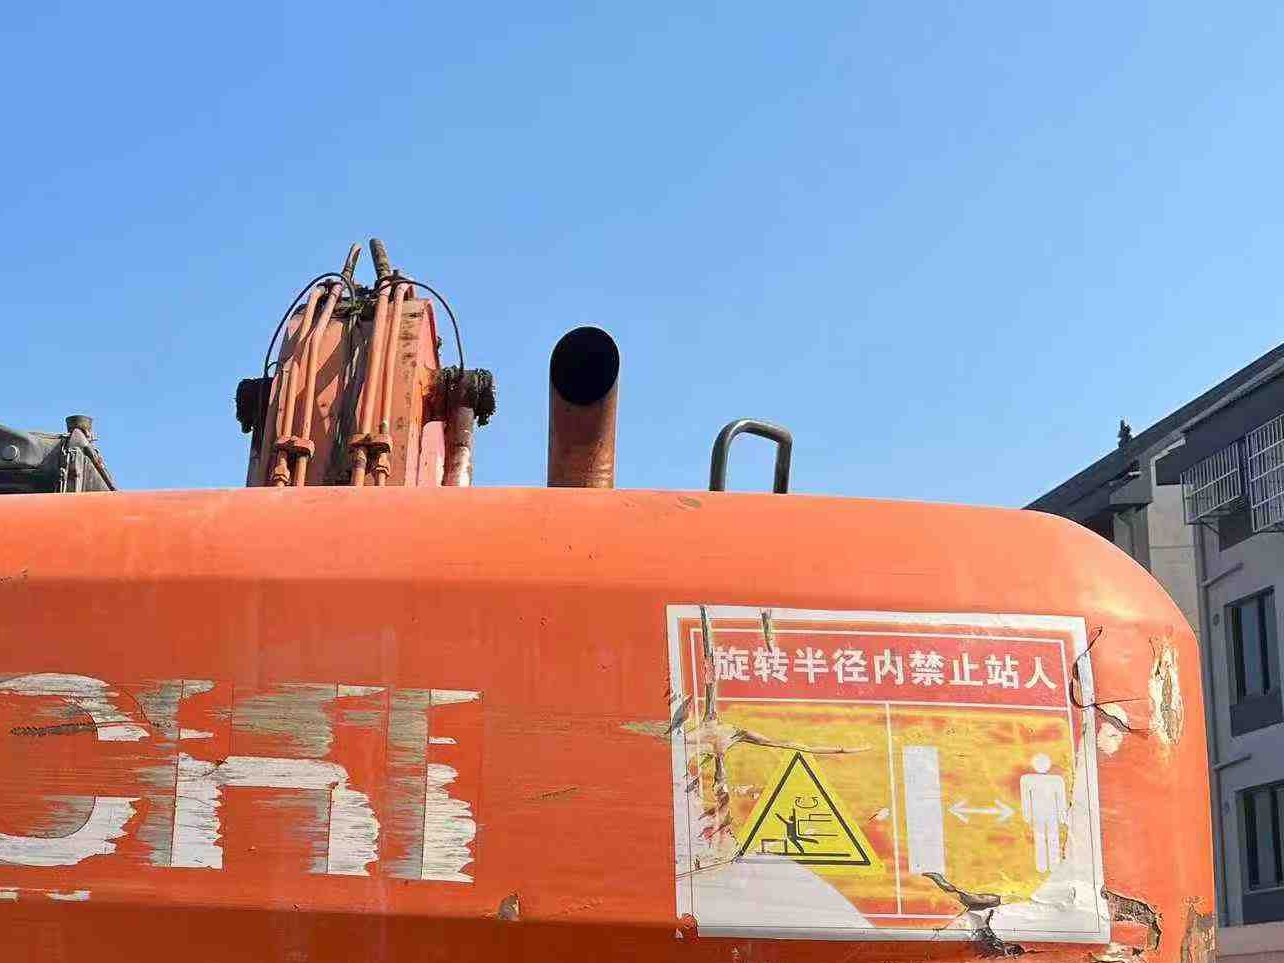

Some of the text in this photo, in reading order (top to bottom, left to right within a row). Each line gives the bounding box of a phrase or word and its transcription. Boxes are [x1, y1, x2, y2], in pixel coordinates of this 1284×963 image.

[713, 646, 1058, 690] 旋转半径内禁止站人
